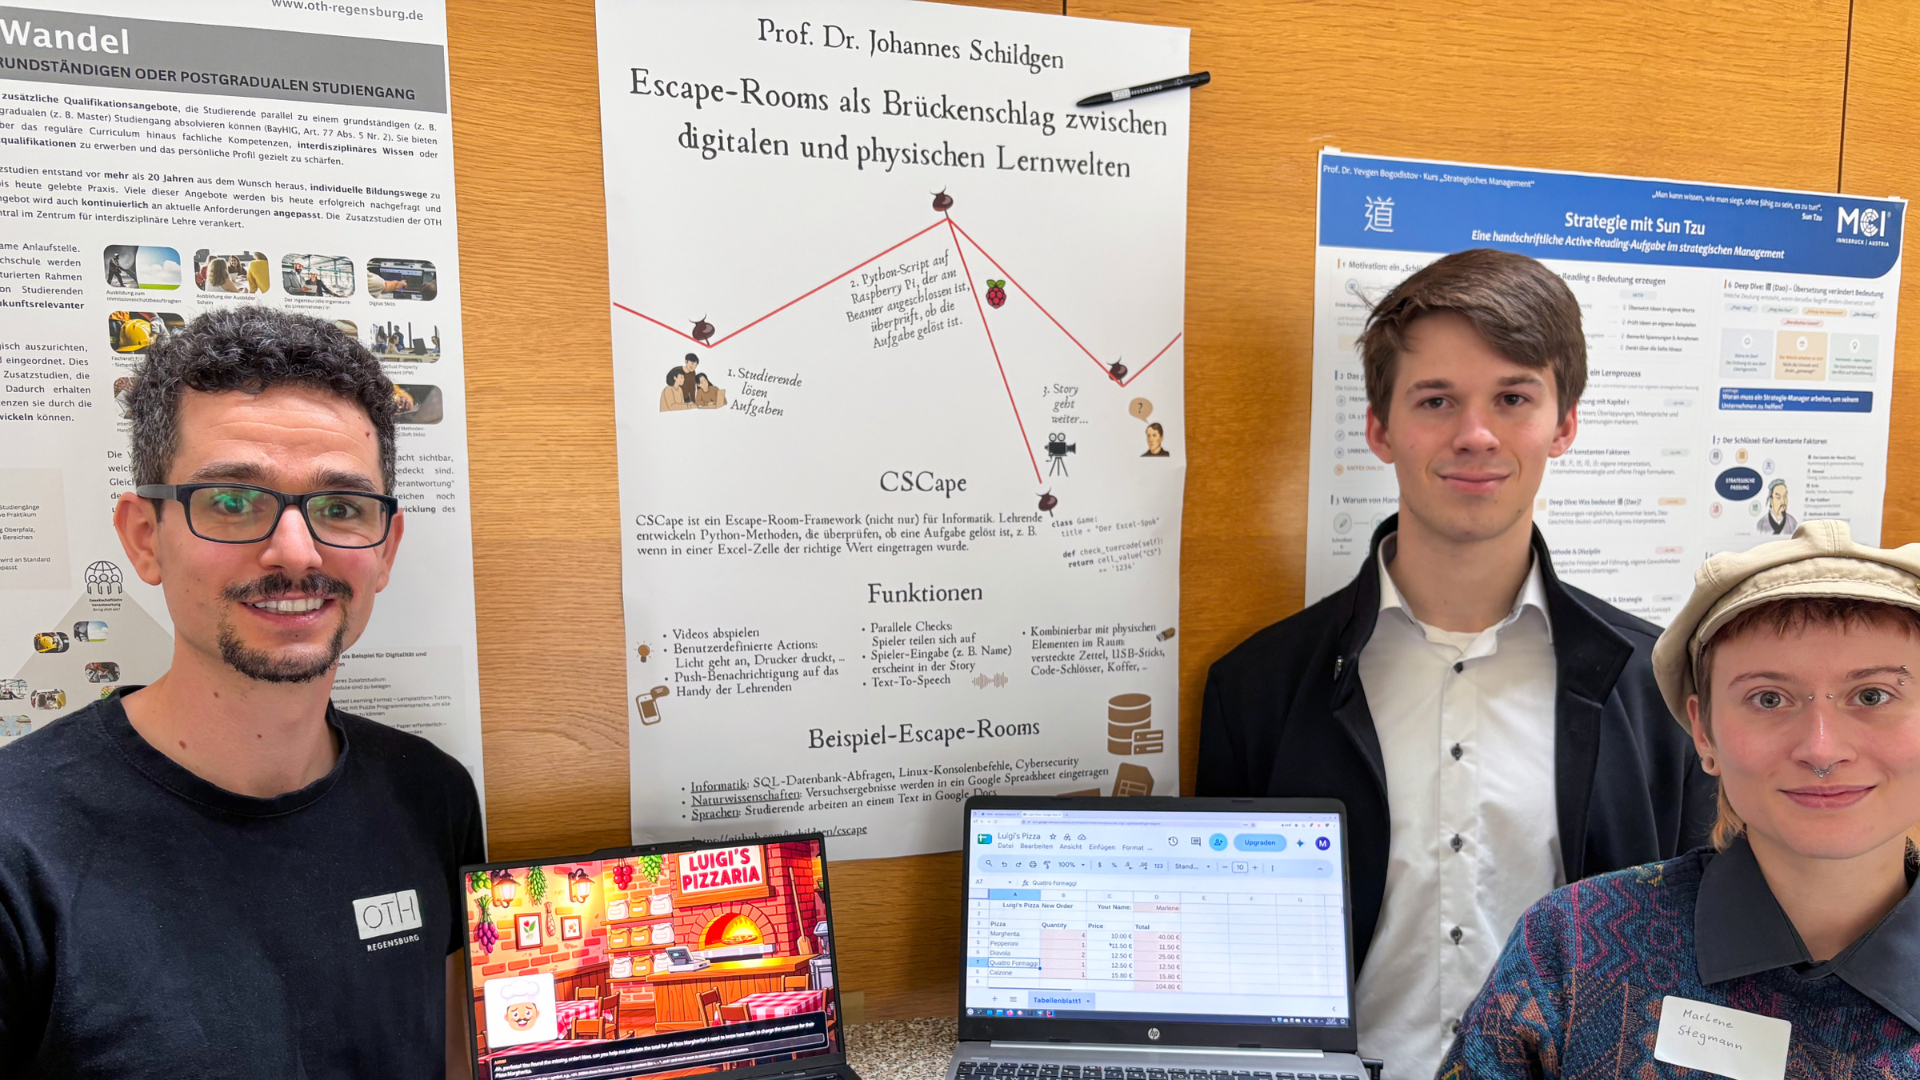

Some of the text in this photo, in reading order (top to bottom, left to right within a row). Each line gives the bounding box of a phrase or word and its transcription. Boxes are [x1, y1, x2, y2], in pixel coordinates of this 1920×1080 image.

[271, 0, 424, 21] www.oth-regensburg.de
[0, 18, 129, 55] Wandel
[757, 18, 1063, 73] Prof. Dr. Johannes Schildgen
[135, 68, 177, 82] ODER
[181, 71, 309, 92] POSTGRADUALEN
[312, 81, 415, 100] STUDIENGANG
[630, 67, 1167, 136] Escape-Rooms als Brückenschlag zwischen
[2, 93, 58, 103] zusätzliche
[64, 96, 180, 113] Qualifikationsangebote,
[185, 105, 199, 113] die
[203, 106, 256, 117] Studierende
[261, 111, 293, 120] parallel
[312, 115, 339, 123] einem
[343, 118, 410, 130] grundständigen
[678, 122, 1130, 178] digitalen und physischen Lernwelten
[1323, 163, 1340, 174] Prof.
[1341, 166, 1352, 174] Dr.
[1353, 167, 1379, 178] Yevgen
[1380, 169, 1419, 180] Bogodistov
[1423, 172, 1438, 181] Kurs
[42, 169, 82, 177] entstand
[104, 171, 129, 179] mehr
[132, 172, 144, 180] als
[148, 173, 160, 181] 20
[162, 174, 194, 183] Jahren
[215, 177, 234, 185] dem
[237, 179, 272, 188] Wunsch
[275, 180, 307, 191] heraus,
[310, 183, 363, 194] individuelle
[366, 187, 427, 199] Bildungswege
[1364, 195, 1395, 233] 道
[1836, 206, 1886, 237] MCI
[1564, 212, 1705, 235] Strategie mit Sun Tzu
[22, 243, 80, 252] Anlaufstelle.
[1472, 230, 1785, 260] Eine handschriftliche Active-Reading-Aufgabe im strategischen Management
[1836, 238, 1890, 247] INNSBRUCK AUSTRIA
[45, 272, 82, 281] Rahmen
[861, 260, 930, 286] Python-Script
[933, 252, 948, 267] auf
[850, 270, 956, 304] Raspberry Pi, der am
[1597, 274, 1666, 287] Bedeutung erzeugen
[22, 285, 83, 295] Studierenden
[846, 279, 970, 322] Beamer angeschlossen ist,
[871, 302, 955, 332] überprüft, ob die
[873, 317, 962, 349] Aufgabe gelöst ist.
[25, 343, 88, 352] auszurichten,
[3, 370, 72, 380] Zusatzstudien,
[738, 367, 802, 387] Studierende
[1601, 369, 1641, 378] Lernprozess
[741, 384, 768, 400] lösen
[1053, 384, 1079, 398] Story
[730, 399, 784, 417] Aufgaben
[1054, 398, 1075, 411] geht
[36, 413, 74, 421] können.
[1051, 414, 1088, 424] weiter...
[419, 454, 454, 462] sichtbar,
[880, 470, 966, 499] CSCape
[635, 510, 1044, 529] CSCape ist ein Escape-Room-Framework (nicht nur) für Informatik. Lehrende
[1051, 520, 1073, 528] class
[1062, 549, 1076, 558] def
[1068, 559, 1094, 568] return
[867, 582, 982, 603] Funktionen
[672, 626, 759, 640] Videos abspielen
[870, 620, 952, 633] Parallele Checks:
[674, 639, 818, 654] Benutzerdefinierte Actions:
[1030, 661, 1139, 676] Code-Schlösser, Koffer,
[871, 673, 950, 688] Text-To-Speech
[808, 718, 1040, 753] Beispiel-Escape-Rooms
[997, 832, 1041, 841] Luigi's Pizza
[1244, 839, 1276, 847] Upgraden
[1088, 843, 1116, 851] Einfügen
[688, 848, 751, 872] LUIGI'S
[682, 865, 760, 891] PIZZARIA
[363, 893, 416, 929] OTH
[990, 920, 1006, 928] Pizza
[366, 934, 420, 952] REGENSBURG
[1683, 1009, 1734, 1029] Marlene
[1678, 1025, 1743, 1051] Stegmann
